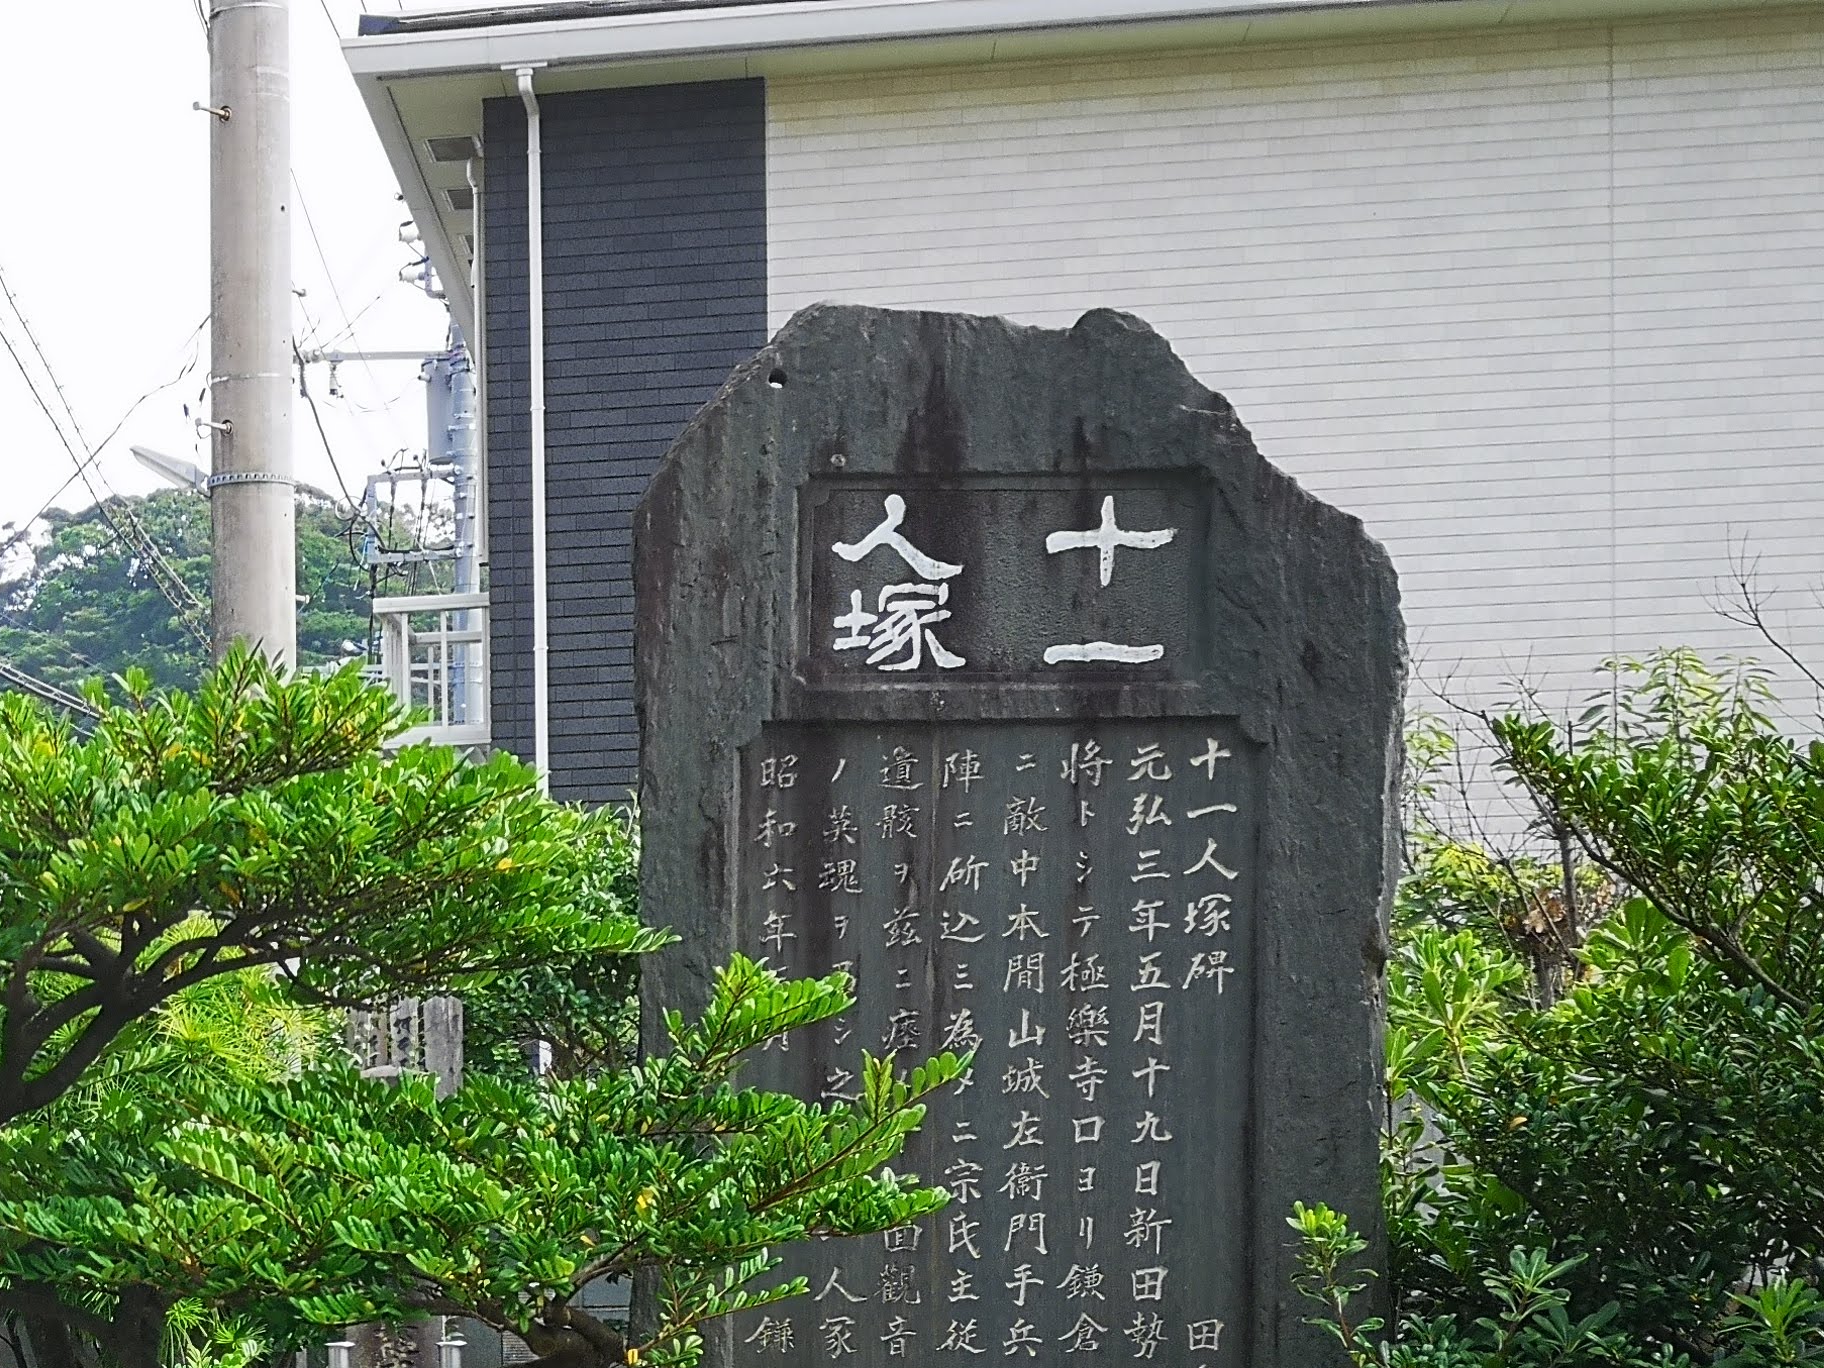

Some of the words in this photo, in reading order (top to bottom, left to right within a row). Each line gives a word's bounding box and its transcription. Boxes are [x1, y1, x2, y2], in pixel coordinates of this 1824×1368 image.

[1183, 737, 1238, 995] 十一人塚碑
